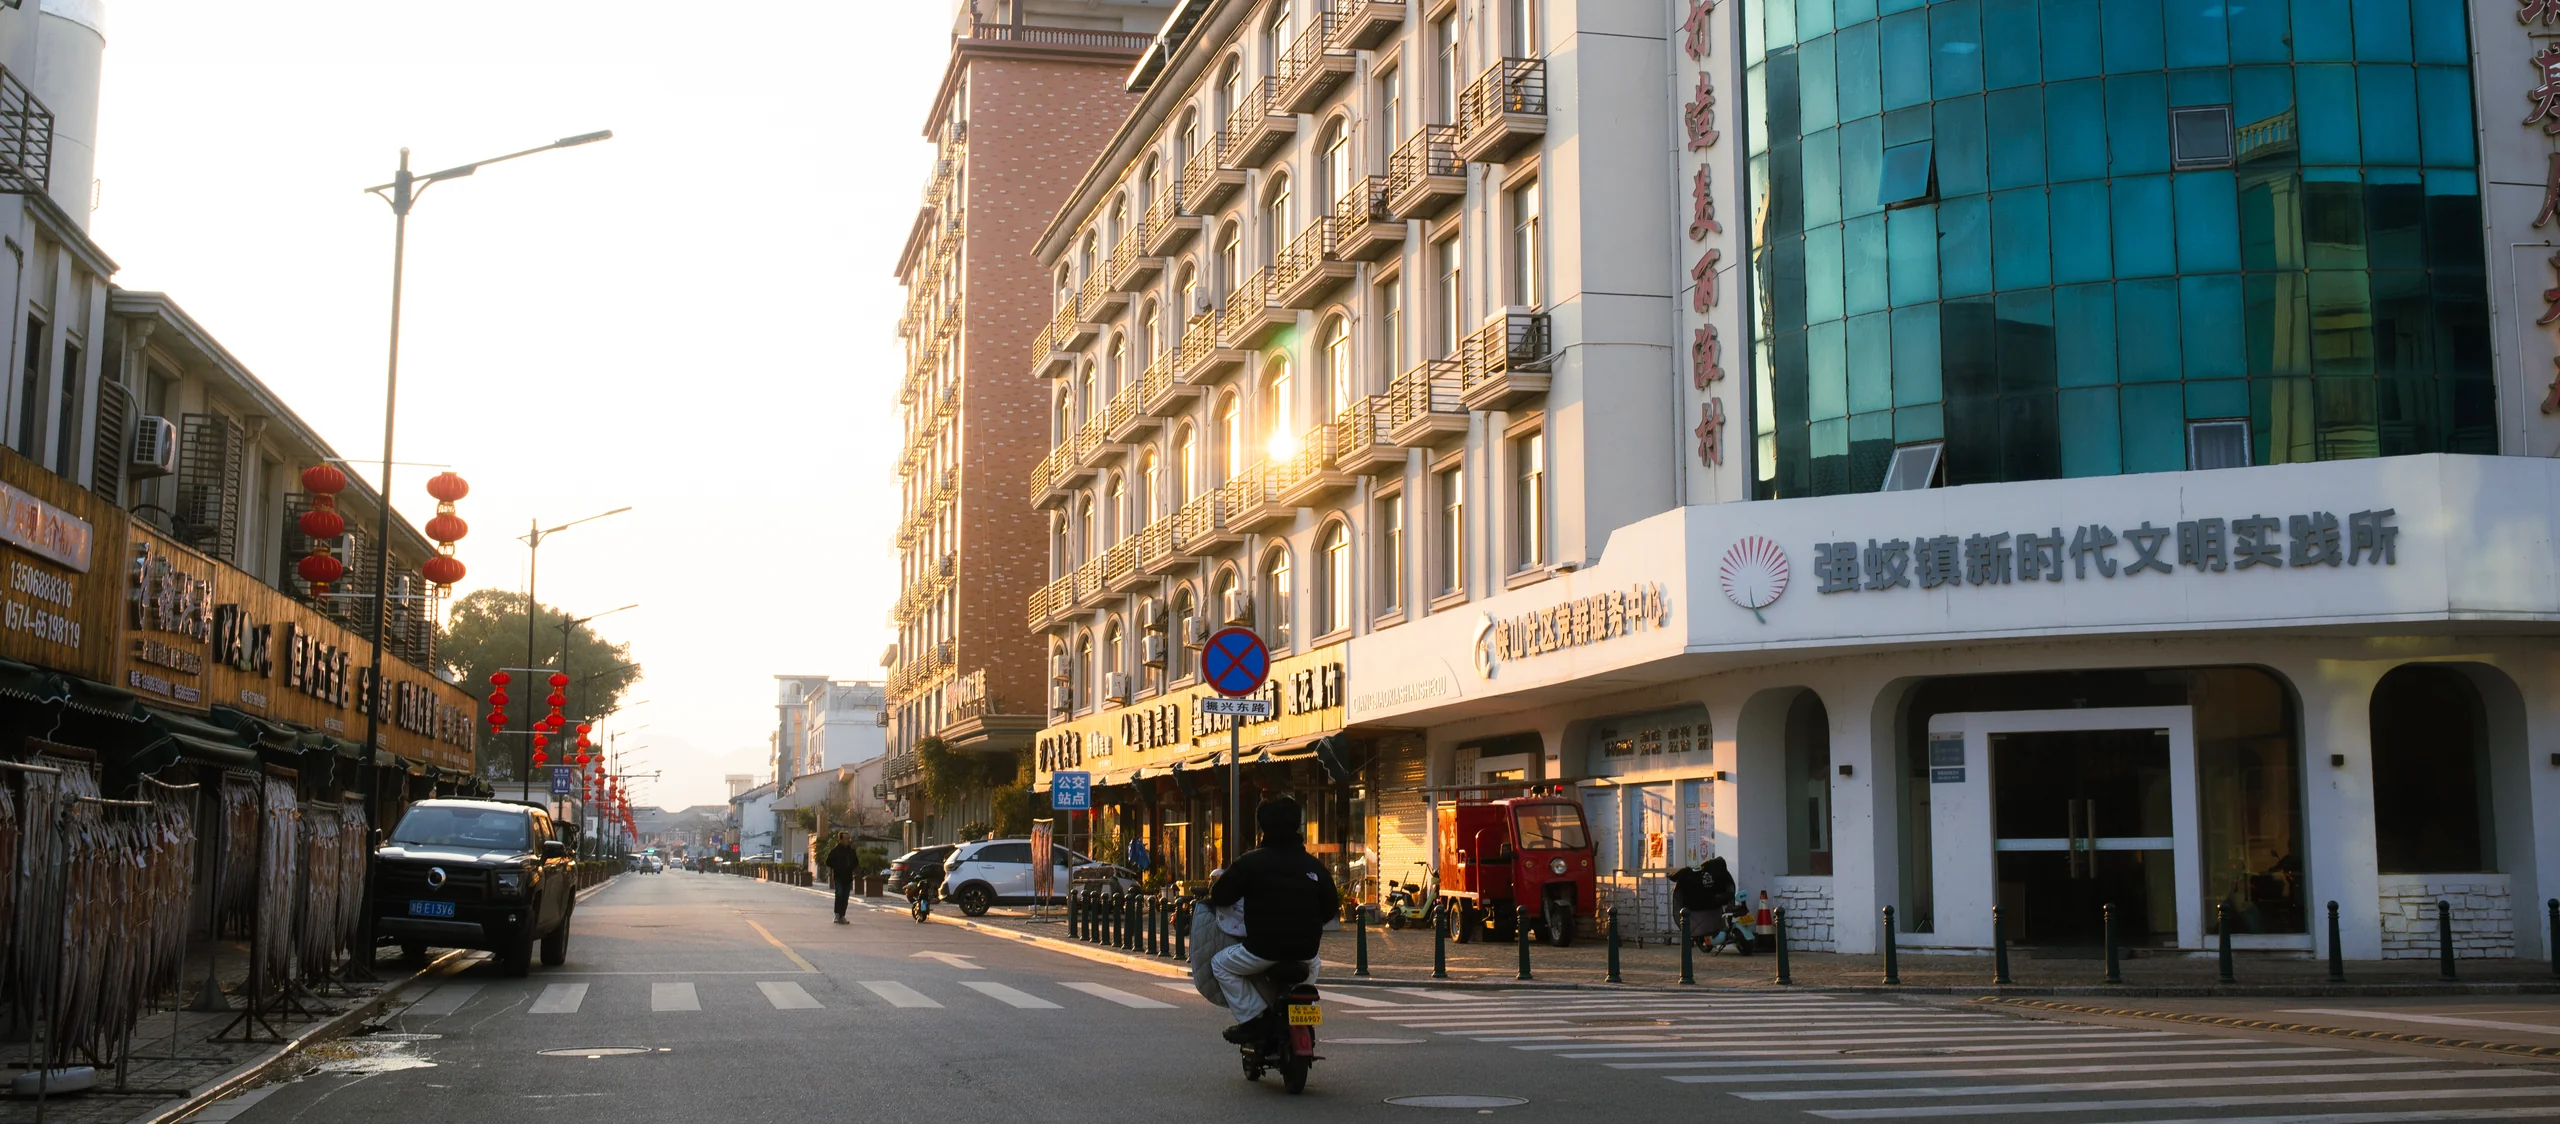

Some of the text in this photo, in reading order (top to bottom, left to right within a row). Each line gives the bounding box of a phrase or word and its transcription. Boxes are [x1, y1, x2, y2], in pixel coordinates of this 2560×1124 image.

[1813, 508, 2398, 594] 强蛟镇新时代文明实践所
[10, 560, 73, 609] 13506888316
[5, 599, 81, 649] 0574-65198119
[1496, 581, 1669, 662] 峡山社区党群服务中心
[1206, 701, 1266, 713] 振兴东路
[1058, 776, 1085, 789] 公交
[1058, 792, 1085, 805] 站点
